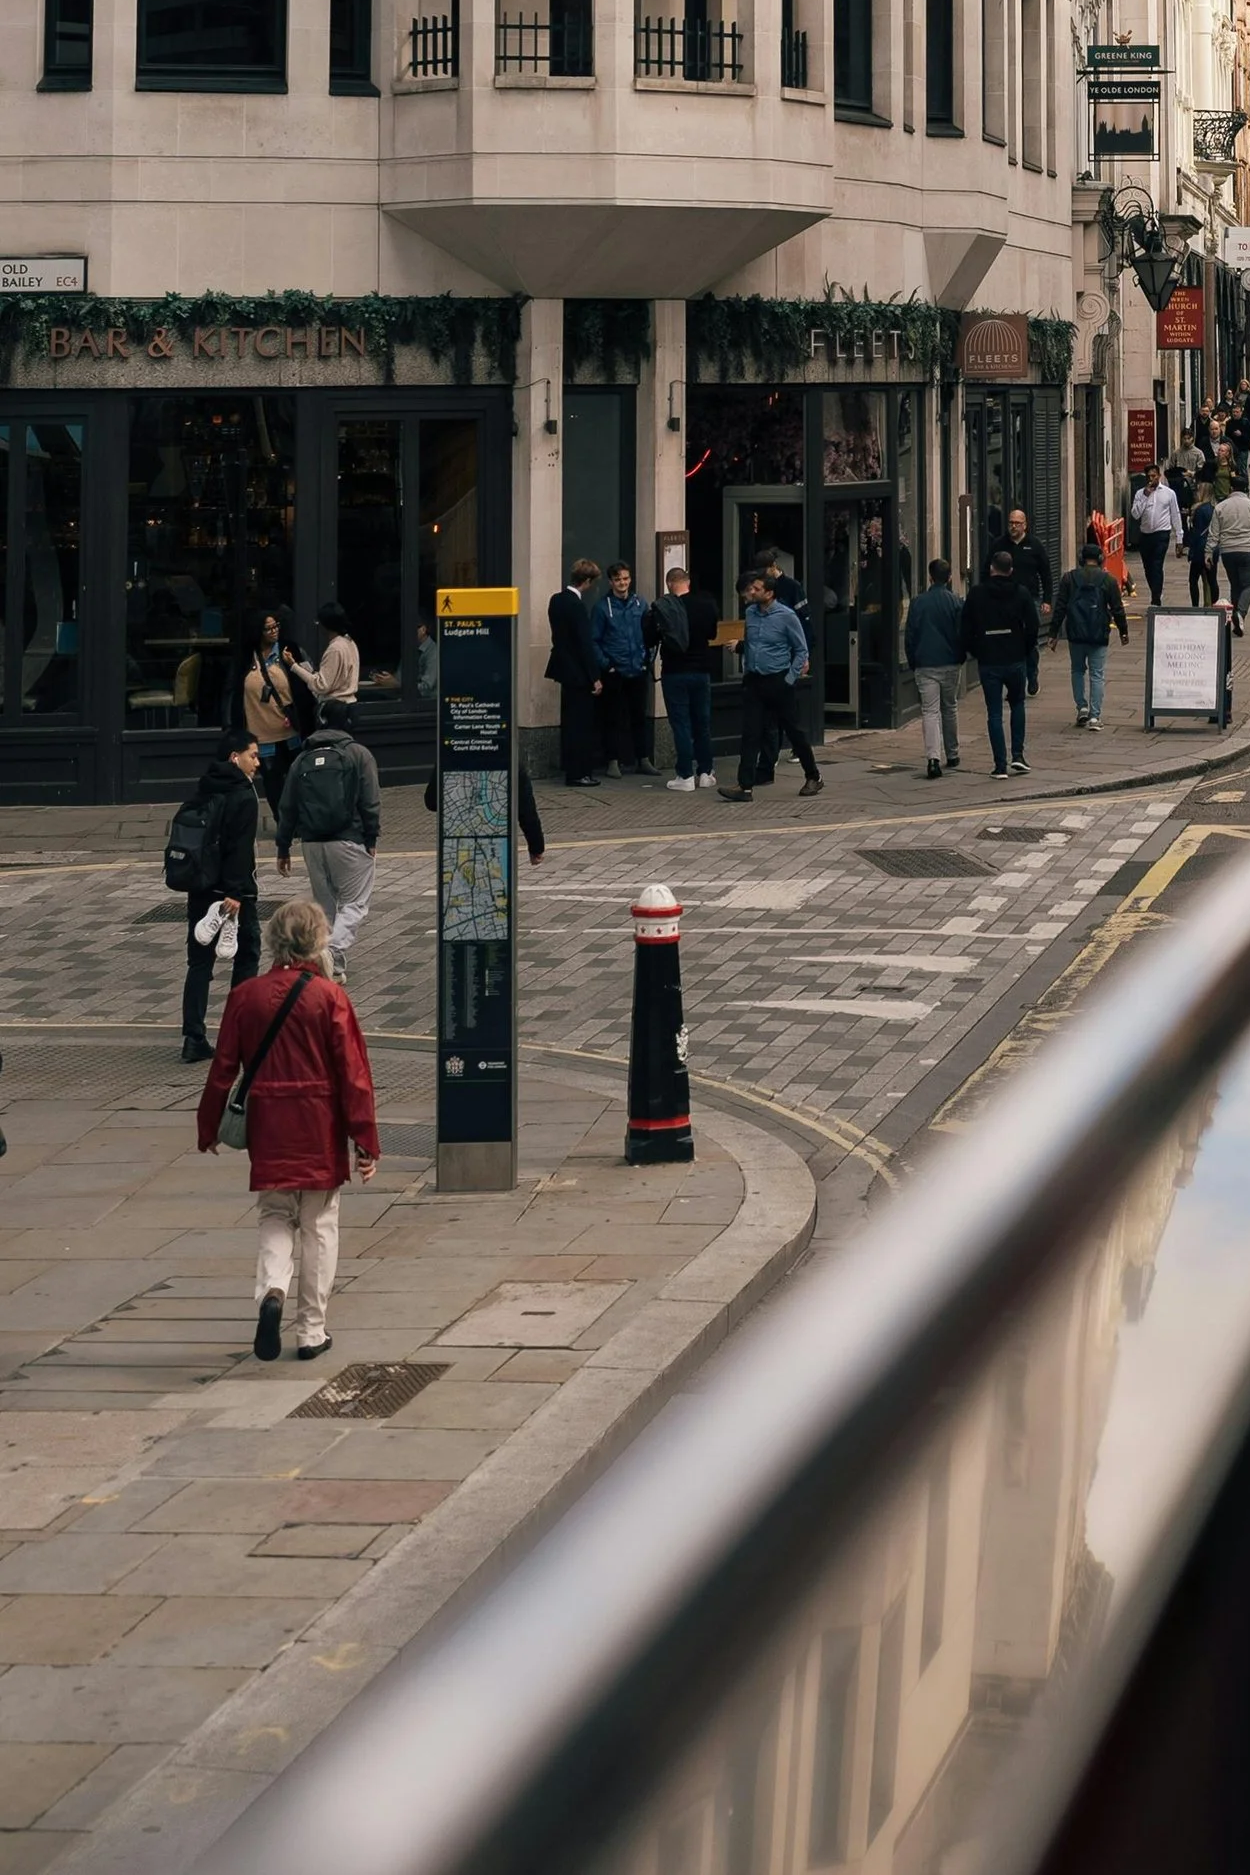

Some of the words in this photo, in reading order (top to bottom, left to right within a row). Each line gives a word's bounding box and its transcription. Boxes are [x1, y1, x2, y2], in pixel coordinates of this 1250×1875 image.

[1094, 52, 1127, 60] GREENE
[1238, 243, 1248, 251] TO
[2, 264, 28, 275] OLD
[2, 277, 43, 288] BAILEY
[56, 276, 78, 287] EC4
[51, 328, 130, 358] BAR
[147, 327, 173, 358] &
[193, 327, 367, 358] KITCHEN
[969, 354, 1018, 364] FLEETS
[444, 628, 475, 637] Ludgate
[476, 628, 489, 636] Hill
[1166, 643, 1206, 651] BIRTHDAY
[1165, 652, 1206, 660] WEDDING
